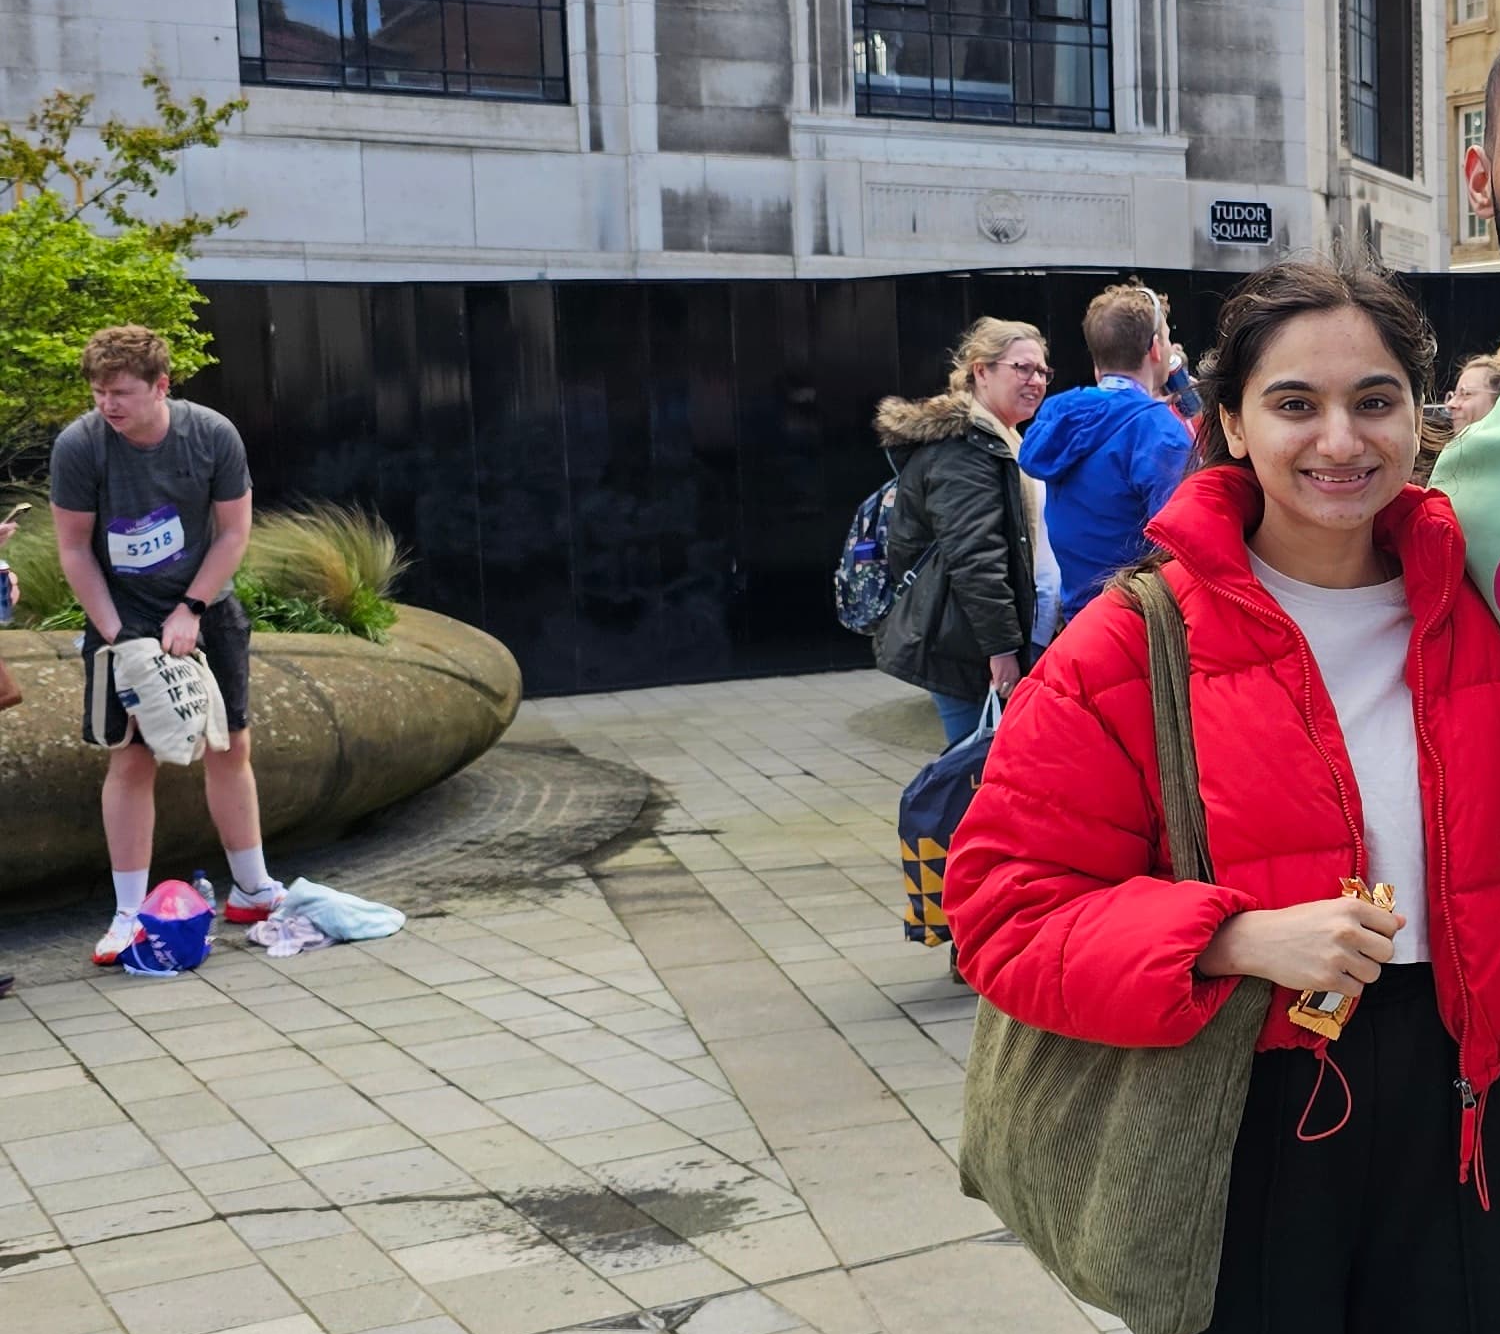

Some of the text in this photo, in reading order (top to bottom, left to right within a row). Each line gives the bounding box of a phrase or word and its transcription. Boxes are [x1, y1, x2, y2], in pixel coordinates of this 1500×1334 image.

[1214, 205, 1267, 222] TUDOR
[1212, 222, 1269, 240] SQUARE
[127, 530, 173, 556] 5218
